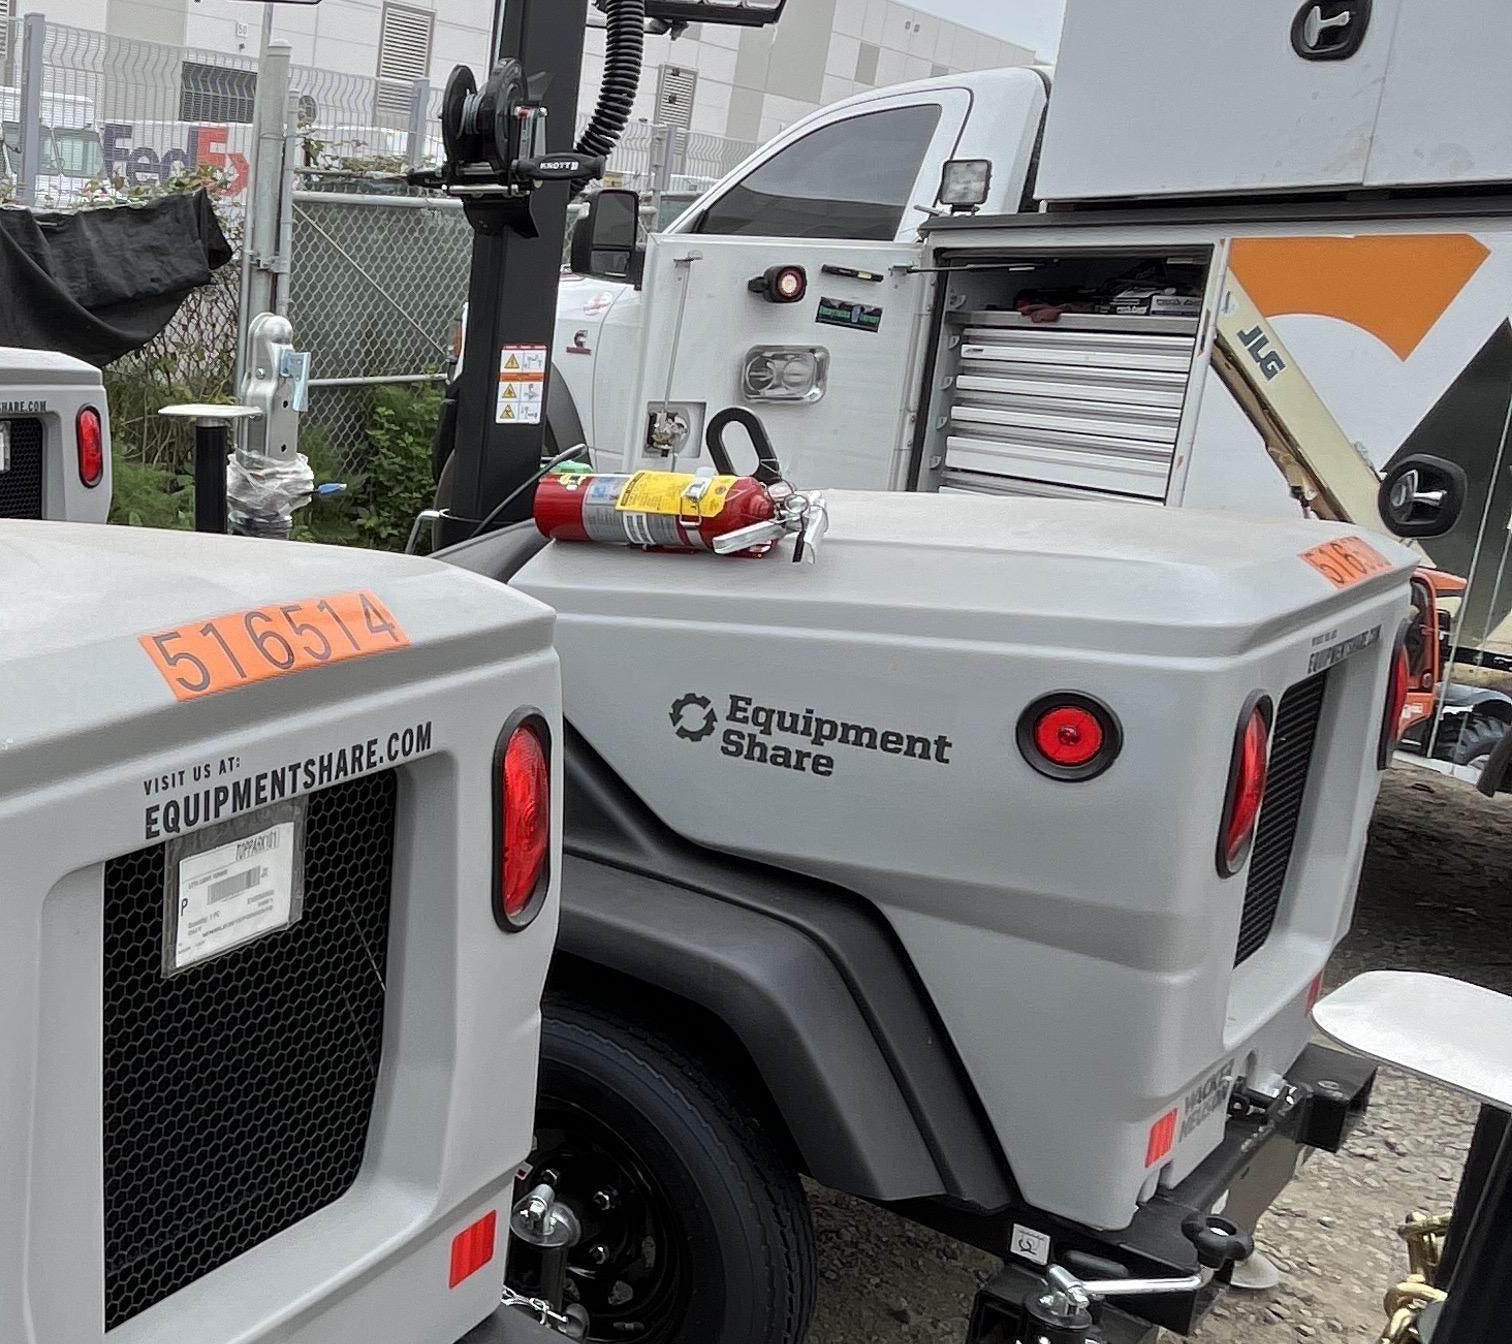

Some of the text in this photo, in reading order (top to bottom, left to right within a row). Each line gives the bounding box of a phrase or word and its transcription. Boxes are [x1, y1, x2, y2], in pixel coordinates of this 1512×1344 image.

[1237, 325, 1286, 381] JLG
[153, 594, 399, 692] 516514
[720, 728, 834, 777] Share
[726, 694, 953, 764] Equipment
[144, 756, 240, 795] VISIT US AT:
[145, 721, 432, 840] EQUIPMENTSHARE.COM
